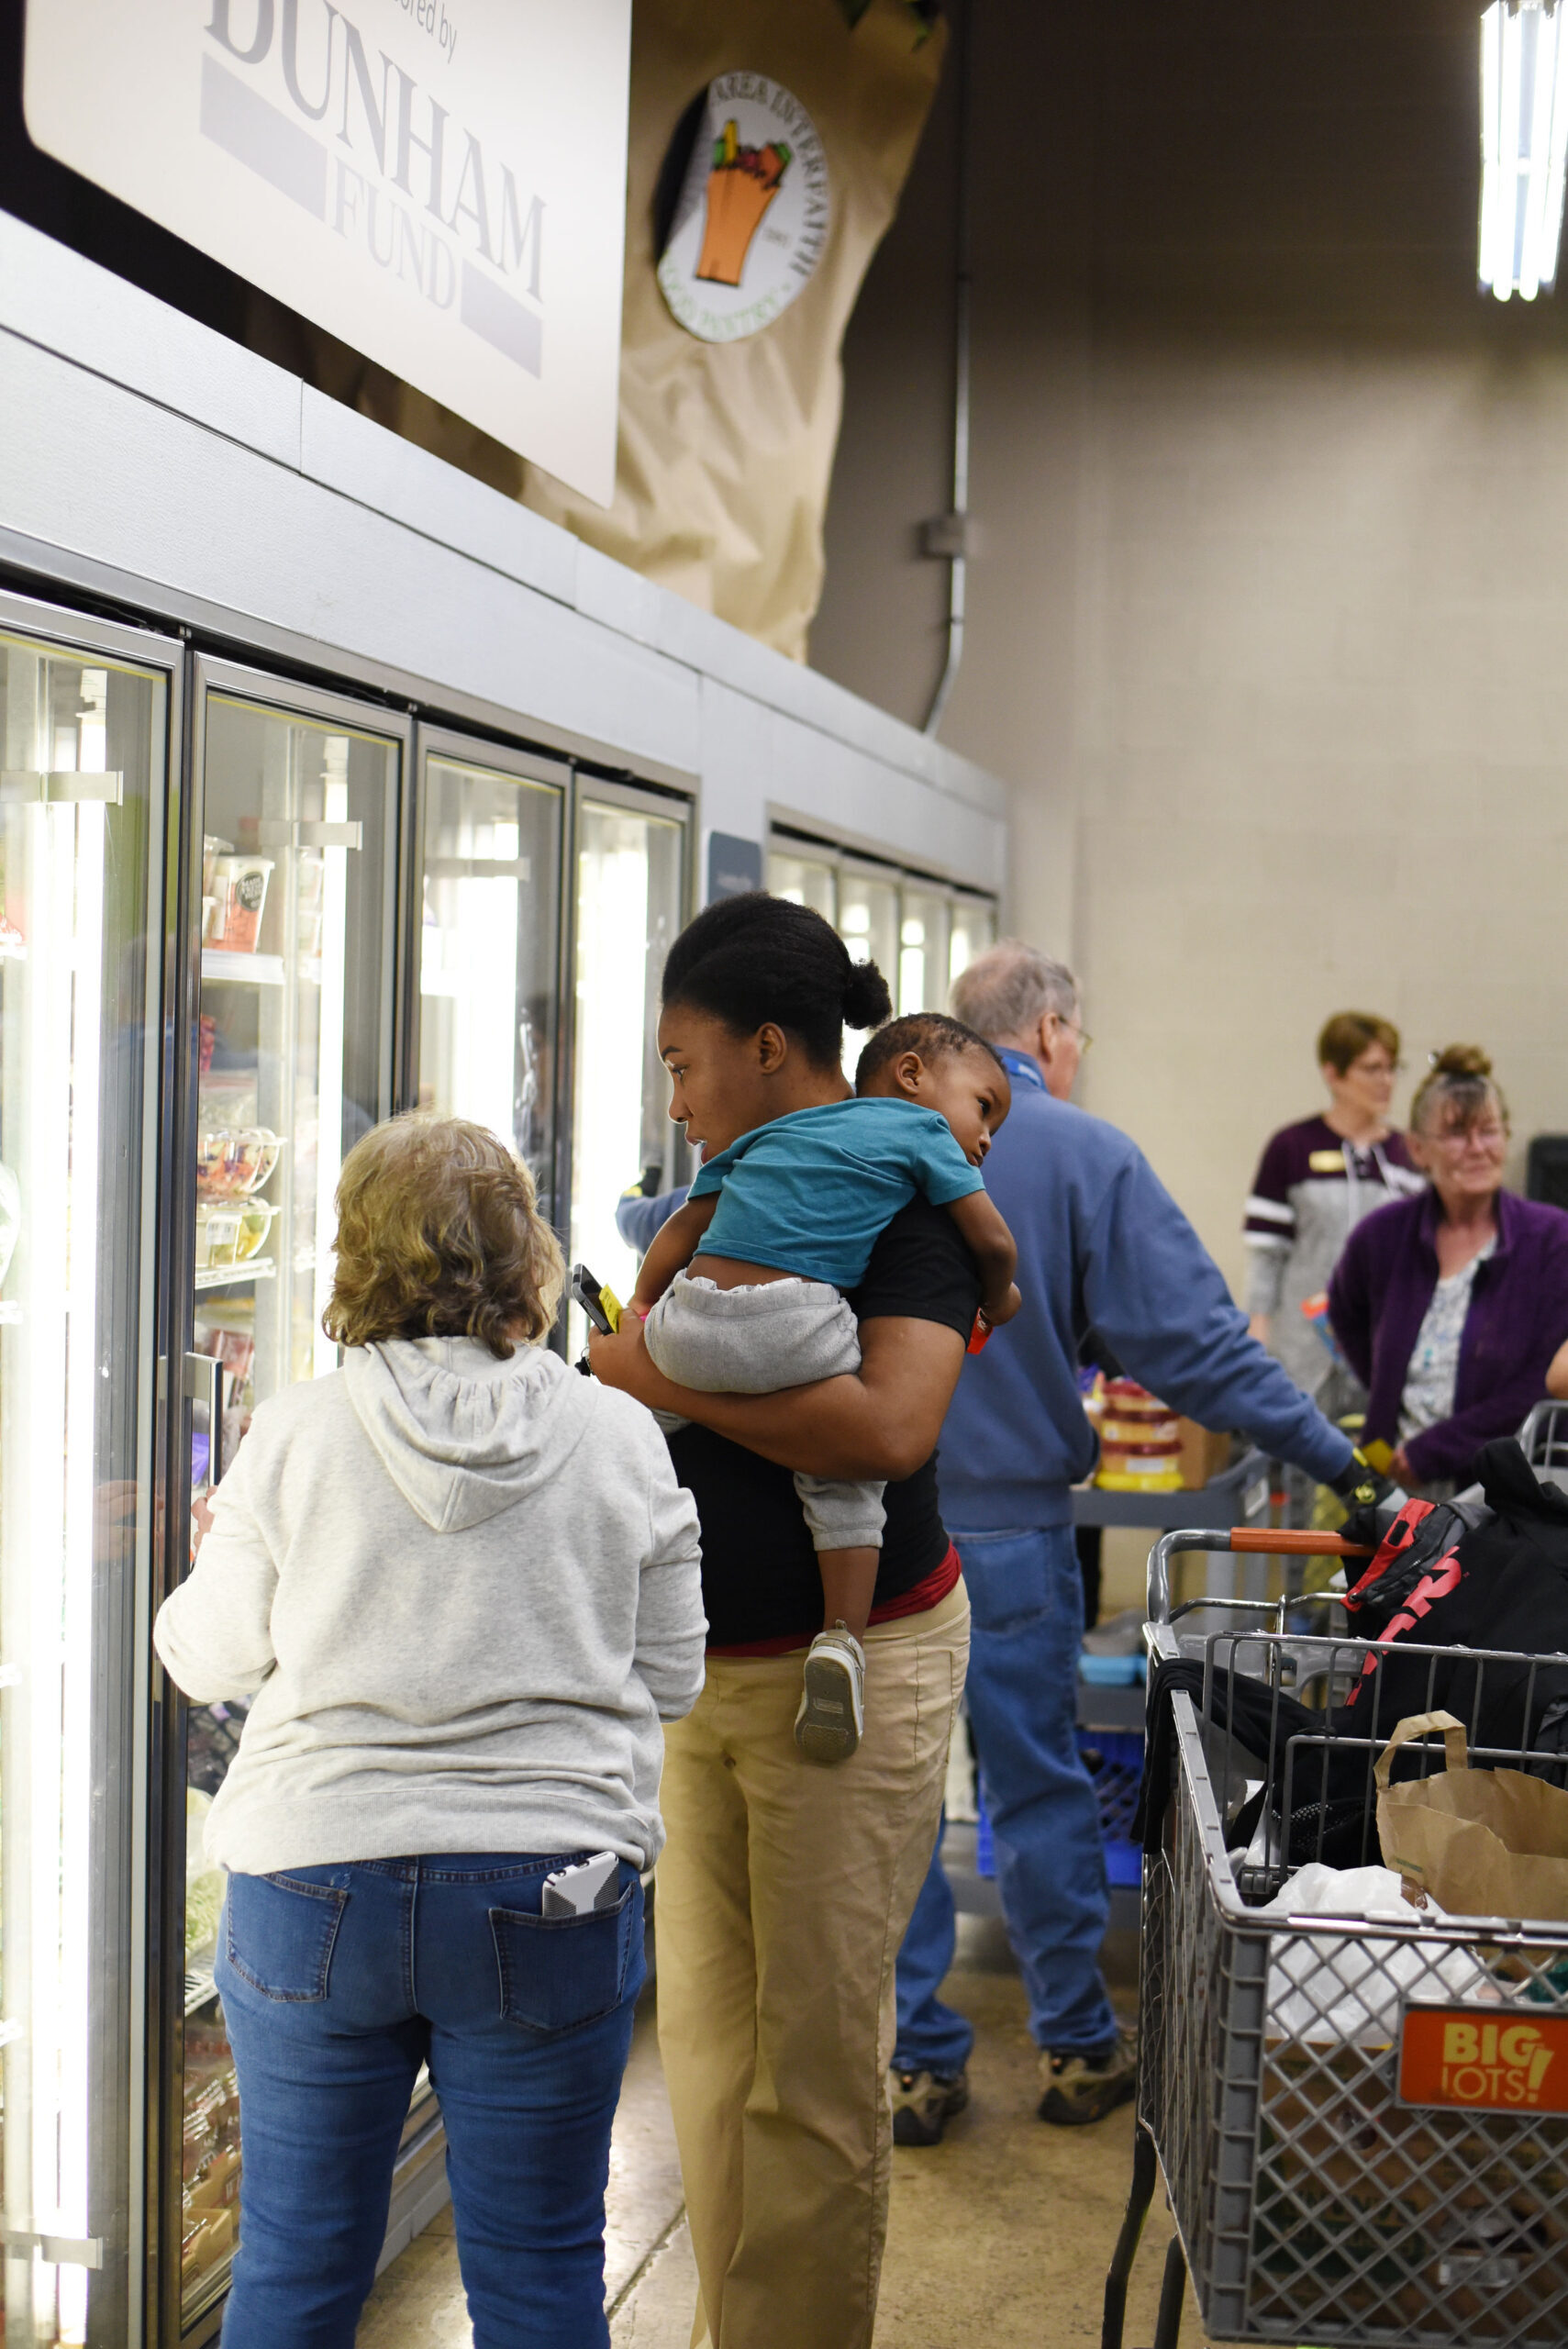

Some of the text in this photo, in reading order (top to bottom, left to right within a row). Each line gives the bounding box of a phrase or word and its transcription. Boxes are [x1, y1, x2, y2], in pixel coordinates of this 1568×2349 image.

[439, 2, 457, 65] by
[331, 155, 457, 310] FUND
[1443, 2022, 1544, 2067] BIG
